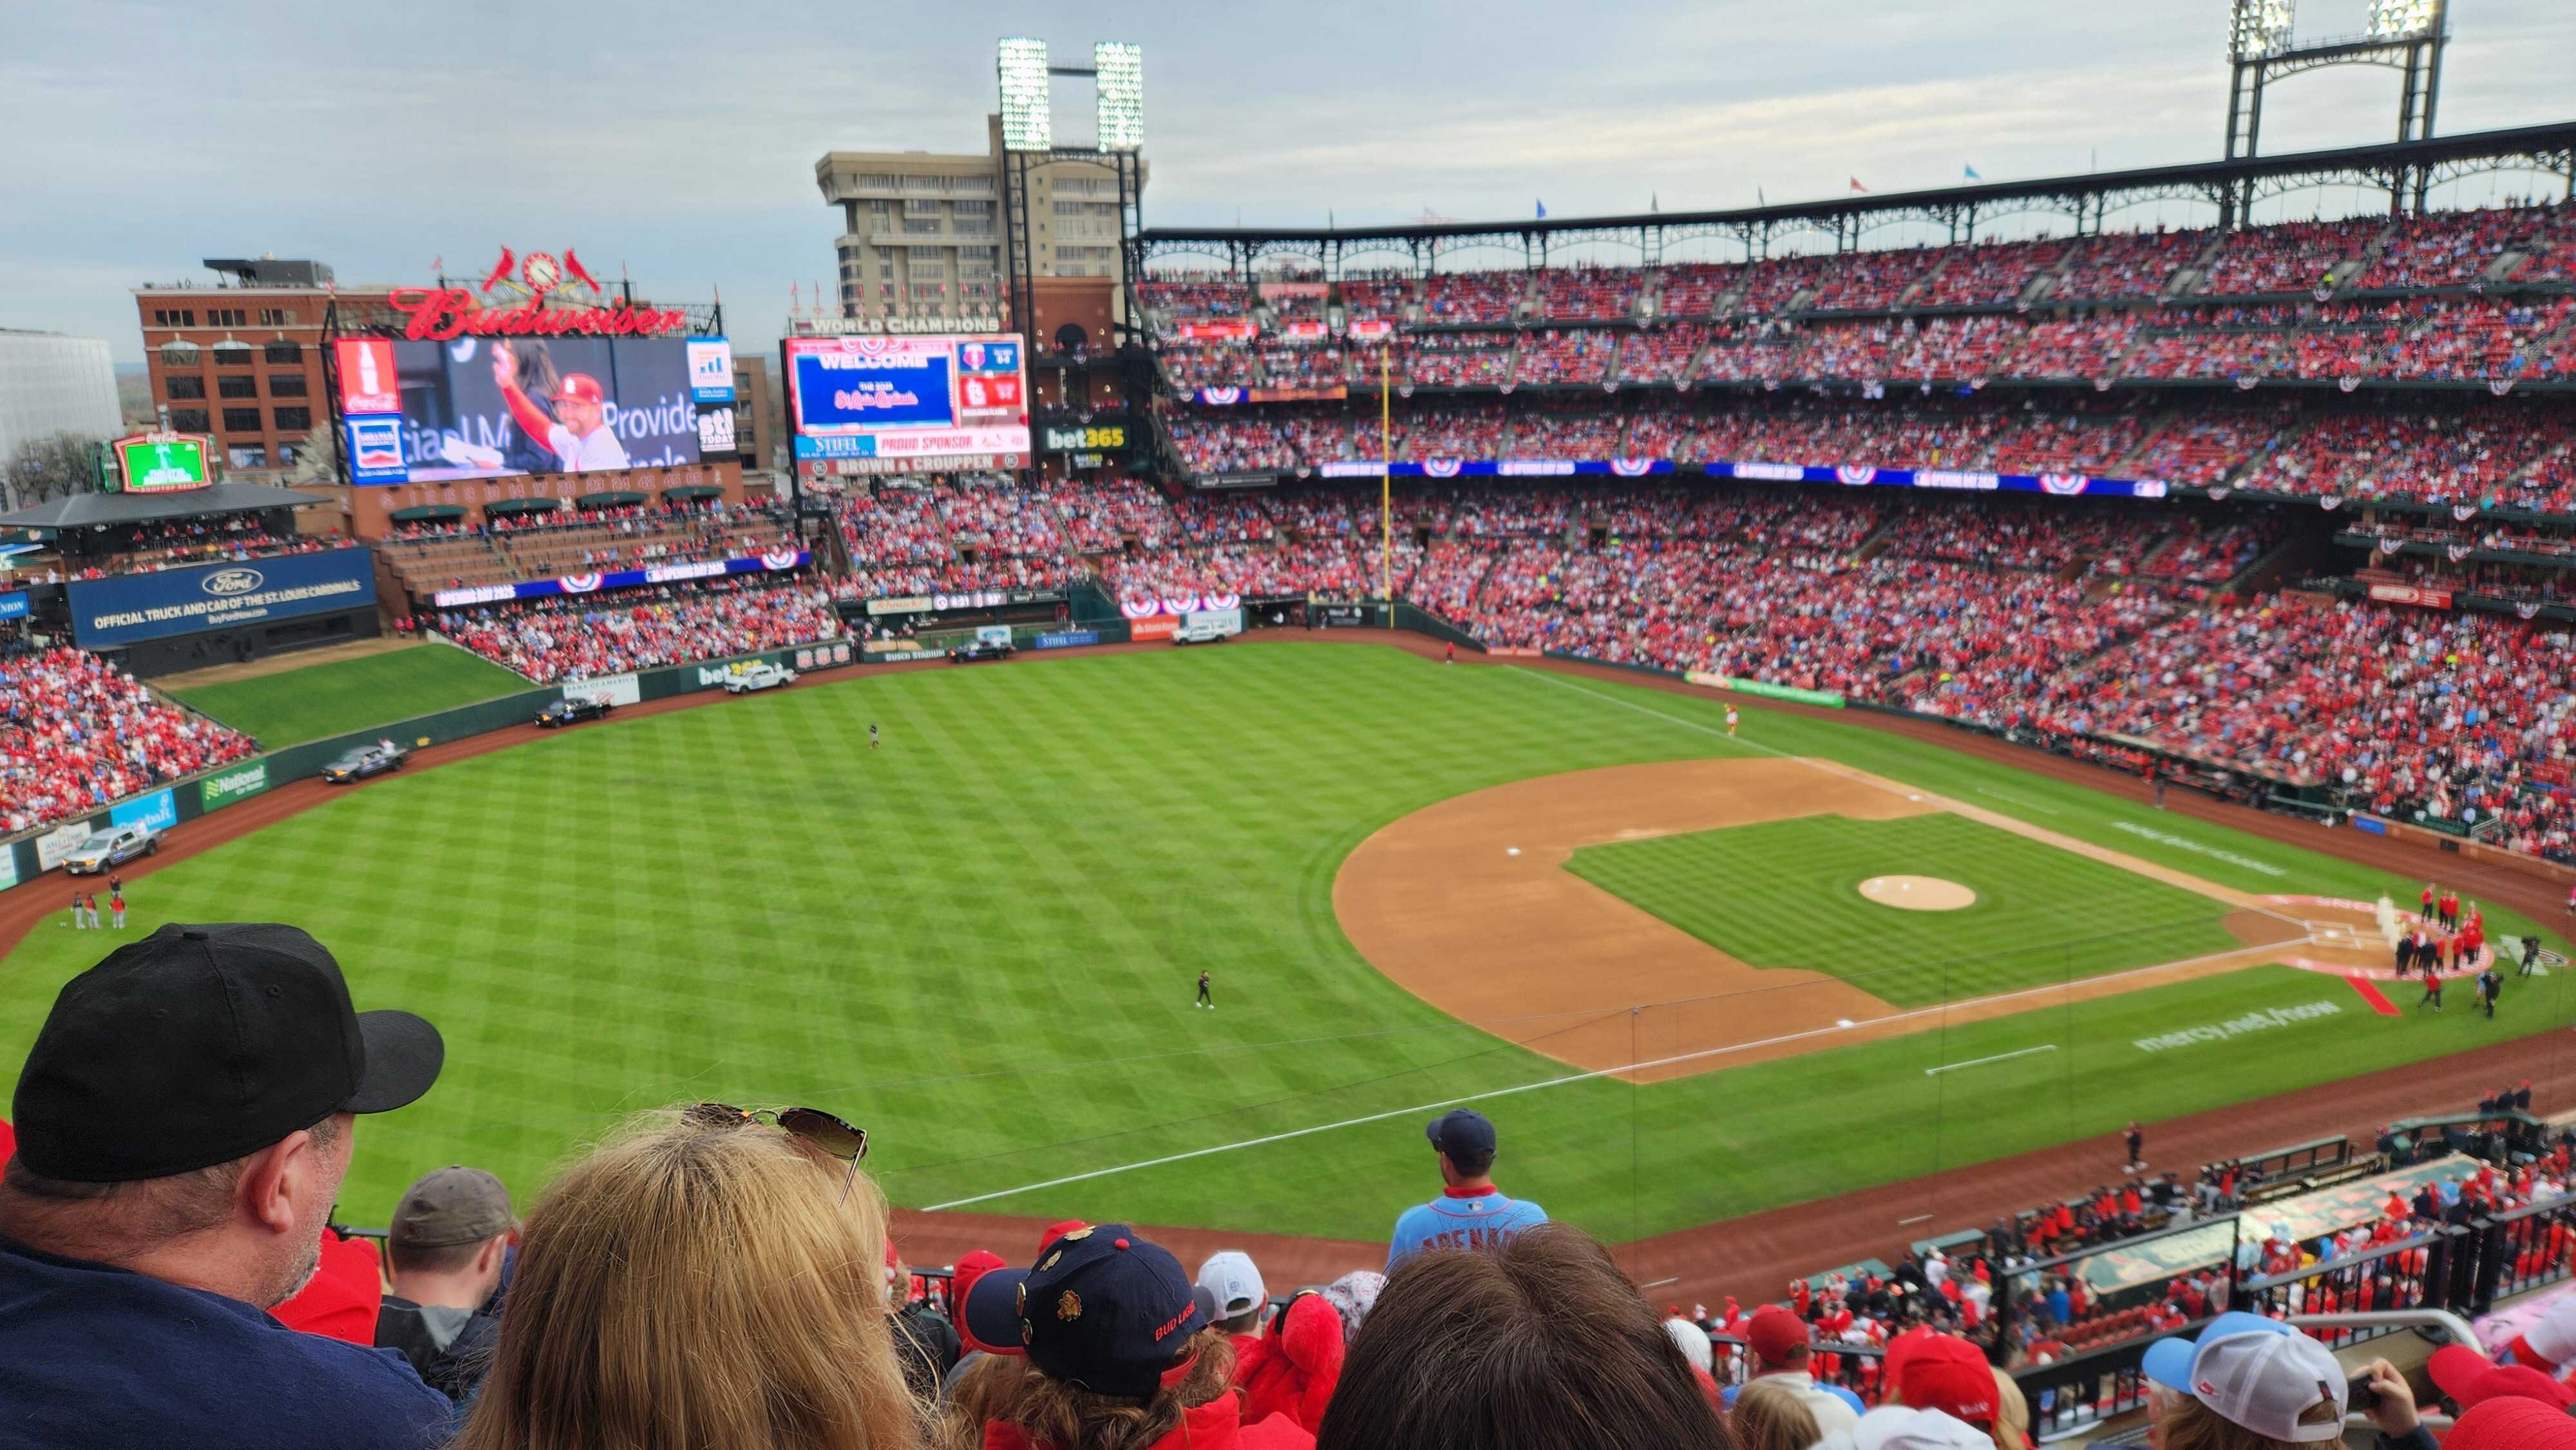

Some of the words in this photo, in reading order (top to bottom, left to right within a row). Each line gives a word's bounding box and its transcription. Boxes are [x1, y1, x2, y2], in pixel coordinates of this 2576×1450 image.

[389, 287, 686, 341] Budweiser
[812, 319, 884, 333] WORLD
[886, 316, 999, 332] CHAMPIONS
[819, 355, 928, 369] WELCOME
[701, 434, 735, 444] TODAY
[814, 437, 860, 451] STIFEL
[882, 437, 919, 451] PROUD
[922, 436, 973, 449] SPONSOR
[1047, 426, 1124, 449] bet365
[838, 458, 895, 474] BROWN
[913, 455, 994, 471] CROUPPEN
[708, 561, 726, 574] 2025
[213, 572, 252, 592] Ford
[494, 584, 515, 601] 2025
[94, 611, 146, 630] OFFICIAL
[144, 605, 182, 621] TRUCK
[182, 601, 206, 616] AND
[207, 598, 228, 612] CAR
[229, 597, 244, 610] OF
[245, 593, 265, 607] THE
[264, 590, 279, 604] ST.
[279, 586, 309, 601] LOUIS
[309, 579, 362, 598] CARDINALS
[1042, 636, 1066, 646] STIFEL
[886, 652, 910, 662] BUSCH
[912, 650, 945, 661] STADIUM
[601, 677, 635, 686] AMERICA
[219, 765, 265, 794] National
[1155, 1318, 1177, 1341] BUD
